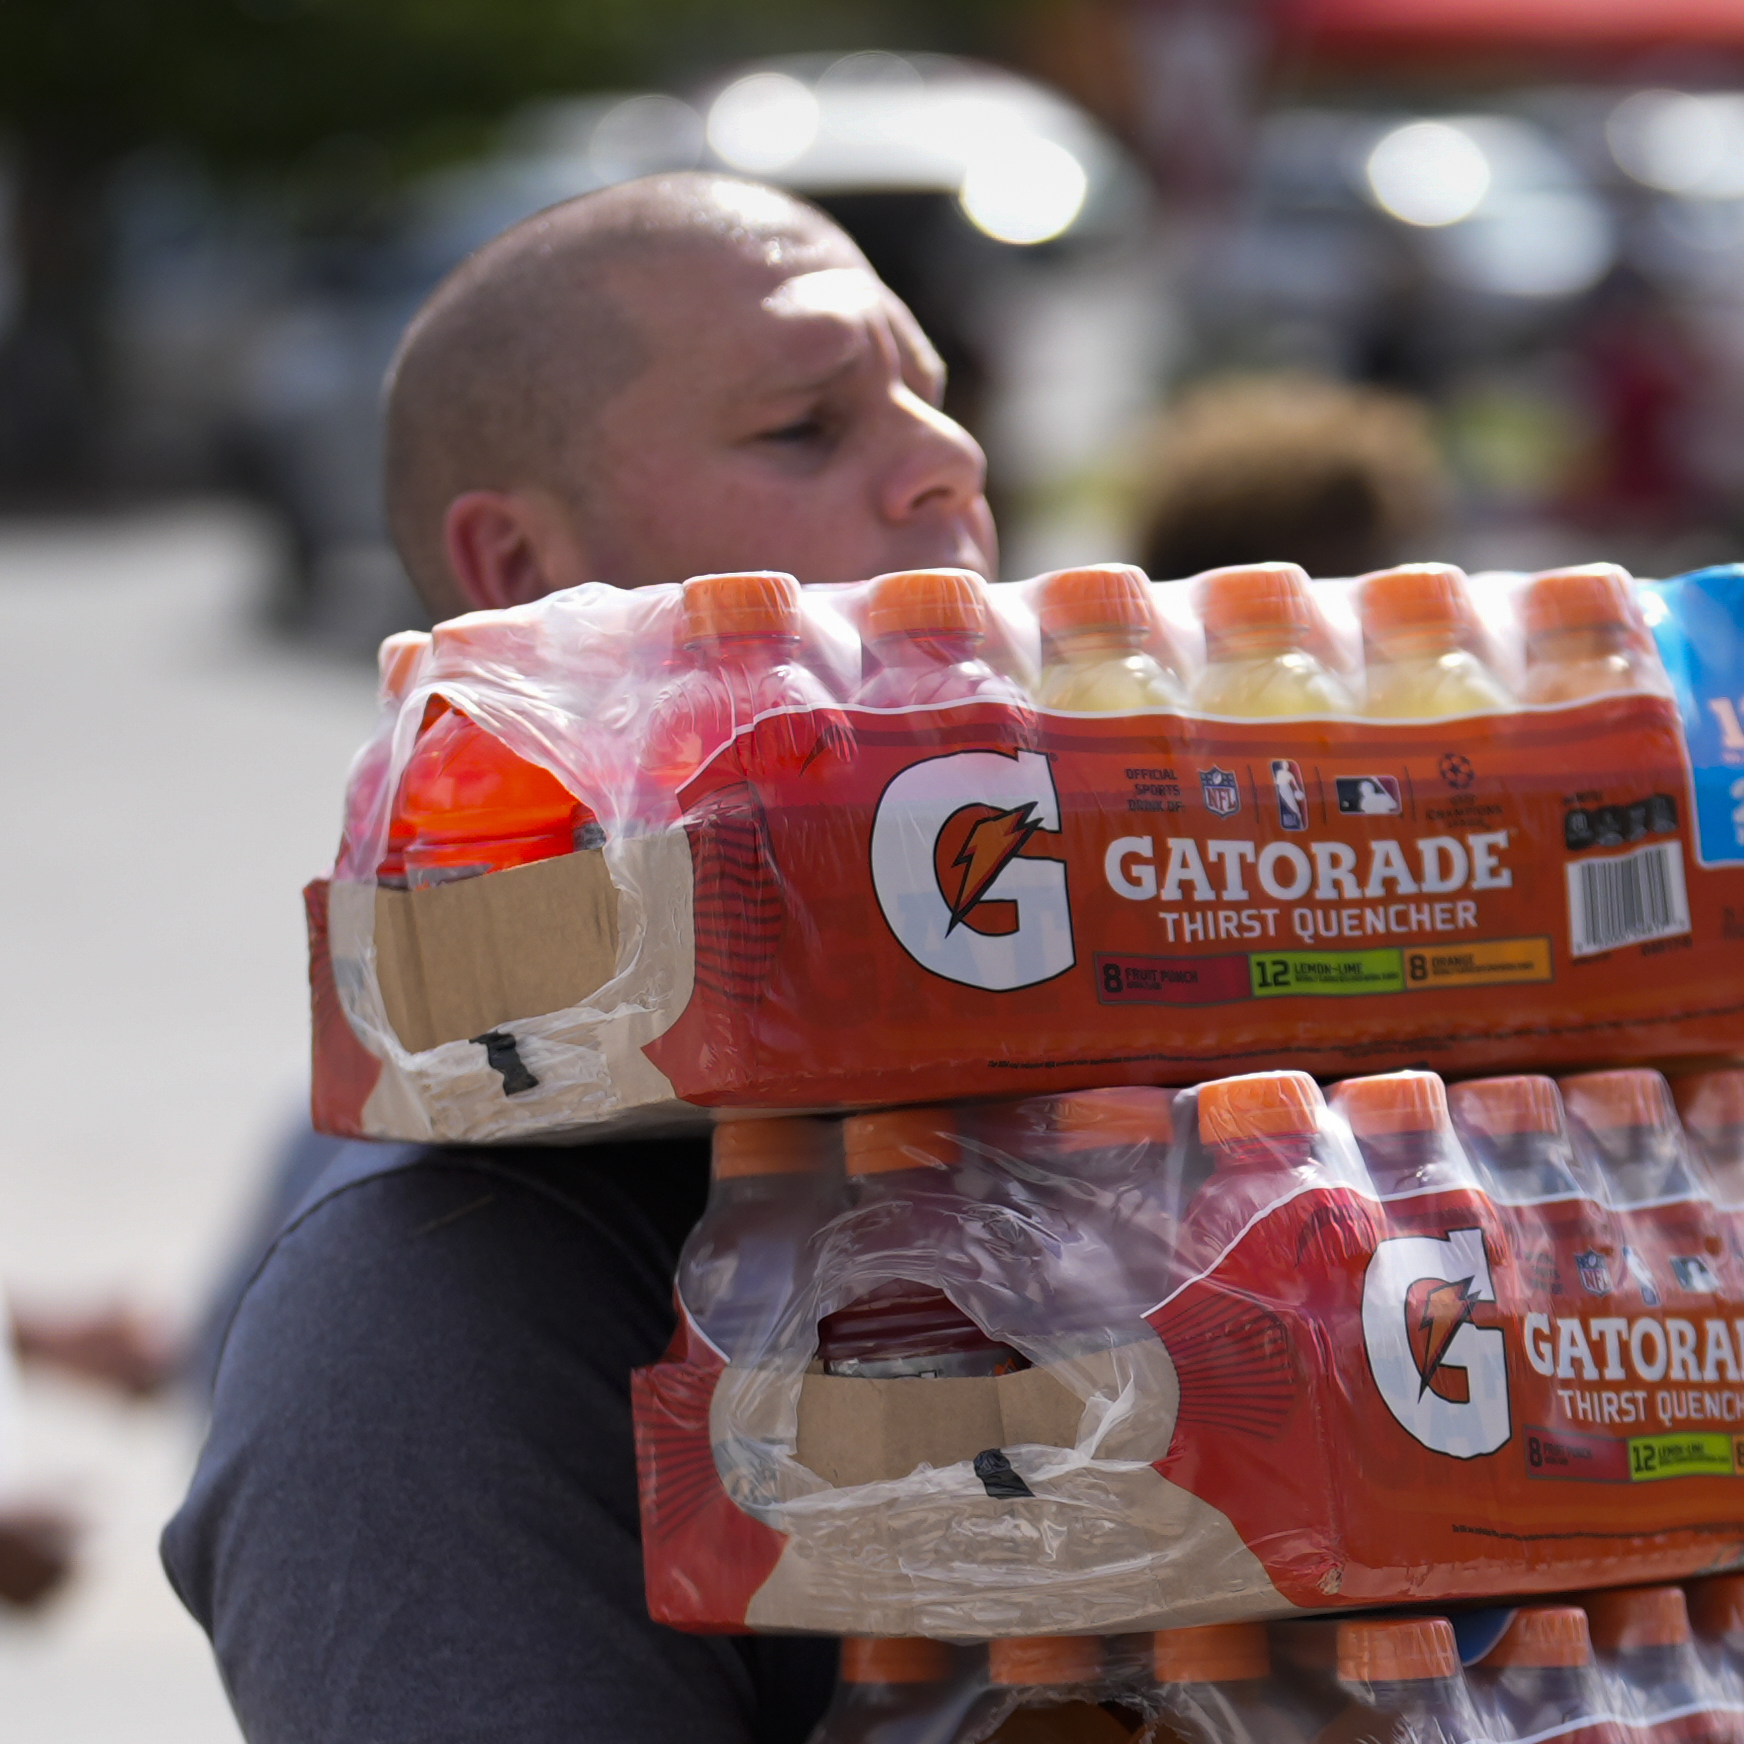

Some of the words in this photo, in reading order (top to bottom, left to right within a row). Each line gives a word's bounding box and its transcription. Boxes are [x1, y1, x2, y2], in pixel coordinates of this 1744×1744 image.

[1124, 768, 1178, 781] OFFICIAL
[1134, 784, 1181, 796] SPORTS
[1206, 787, 1237, 812] NFL
[868, 747, 1077, 992] G
[1104, 830, 1513, 901] GATORADE
[1159, 908, 1281, 943] THIRST
[1292, 900, 1478, 944] QUENCHER
[1103, 963, 1124, 993] 8
[1124, 967, 1158, 981] FRUIT
[1160, 970, 1199, 983] PUNCH
[1256, 960, 1291, 988] 12
[1293, 961, 1364, 976] LEMON-LIME
[1410, 953, 1429, 981] 8
[1431, 954, 1475, 969] ORANGE
[1362, 1227, 1512, 1460] G
[1557, 1389, 1648, 1424] THIRST
[1528, 1437, 1544, 1468] 8
[1632, 1444, 1656, 1473] 12
